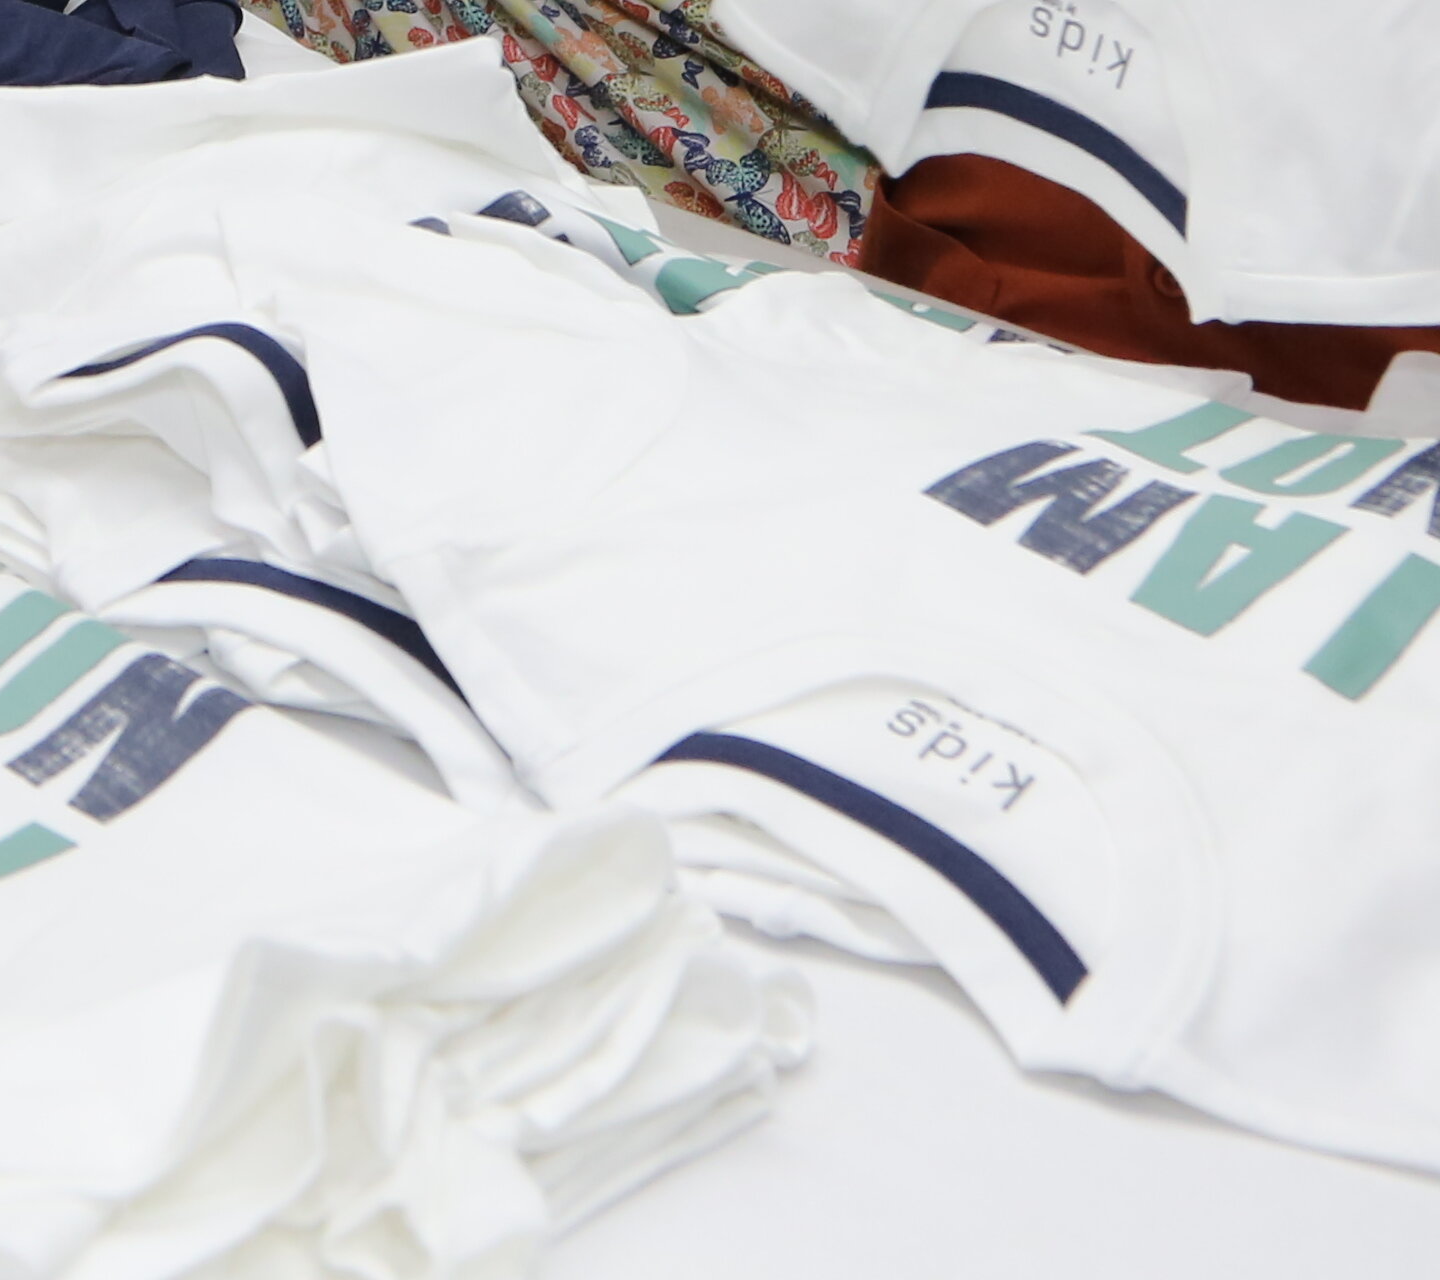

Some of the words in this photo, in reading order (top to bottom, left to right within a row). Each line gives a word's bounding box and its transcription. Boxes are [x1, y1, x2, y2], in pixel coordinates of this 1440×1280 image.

[1029, 6, 1134, 90] kids
[921, 438, 1354, 639] AM
[887, 709, 1035, 811] kids
